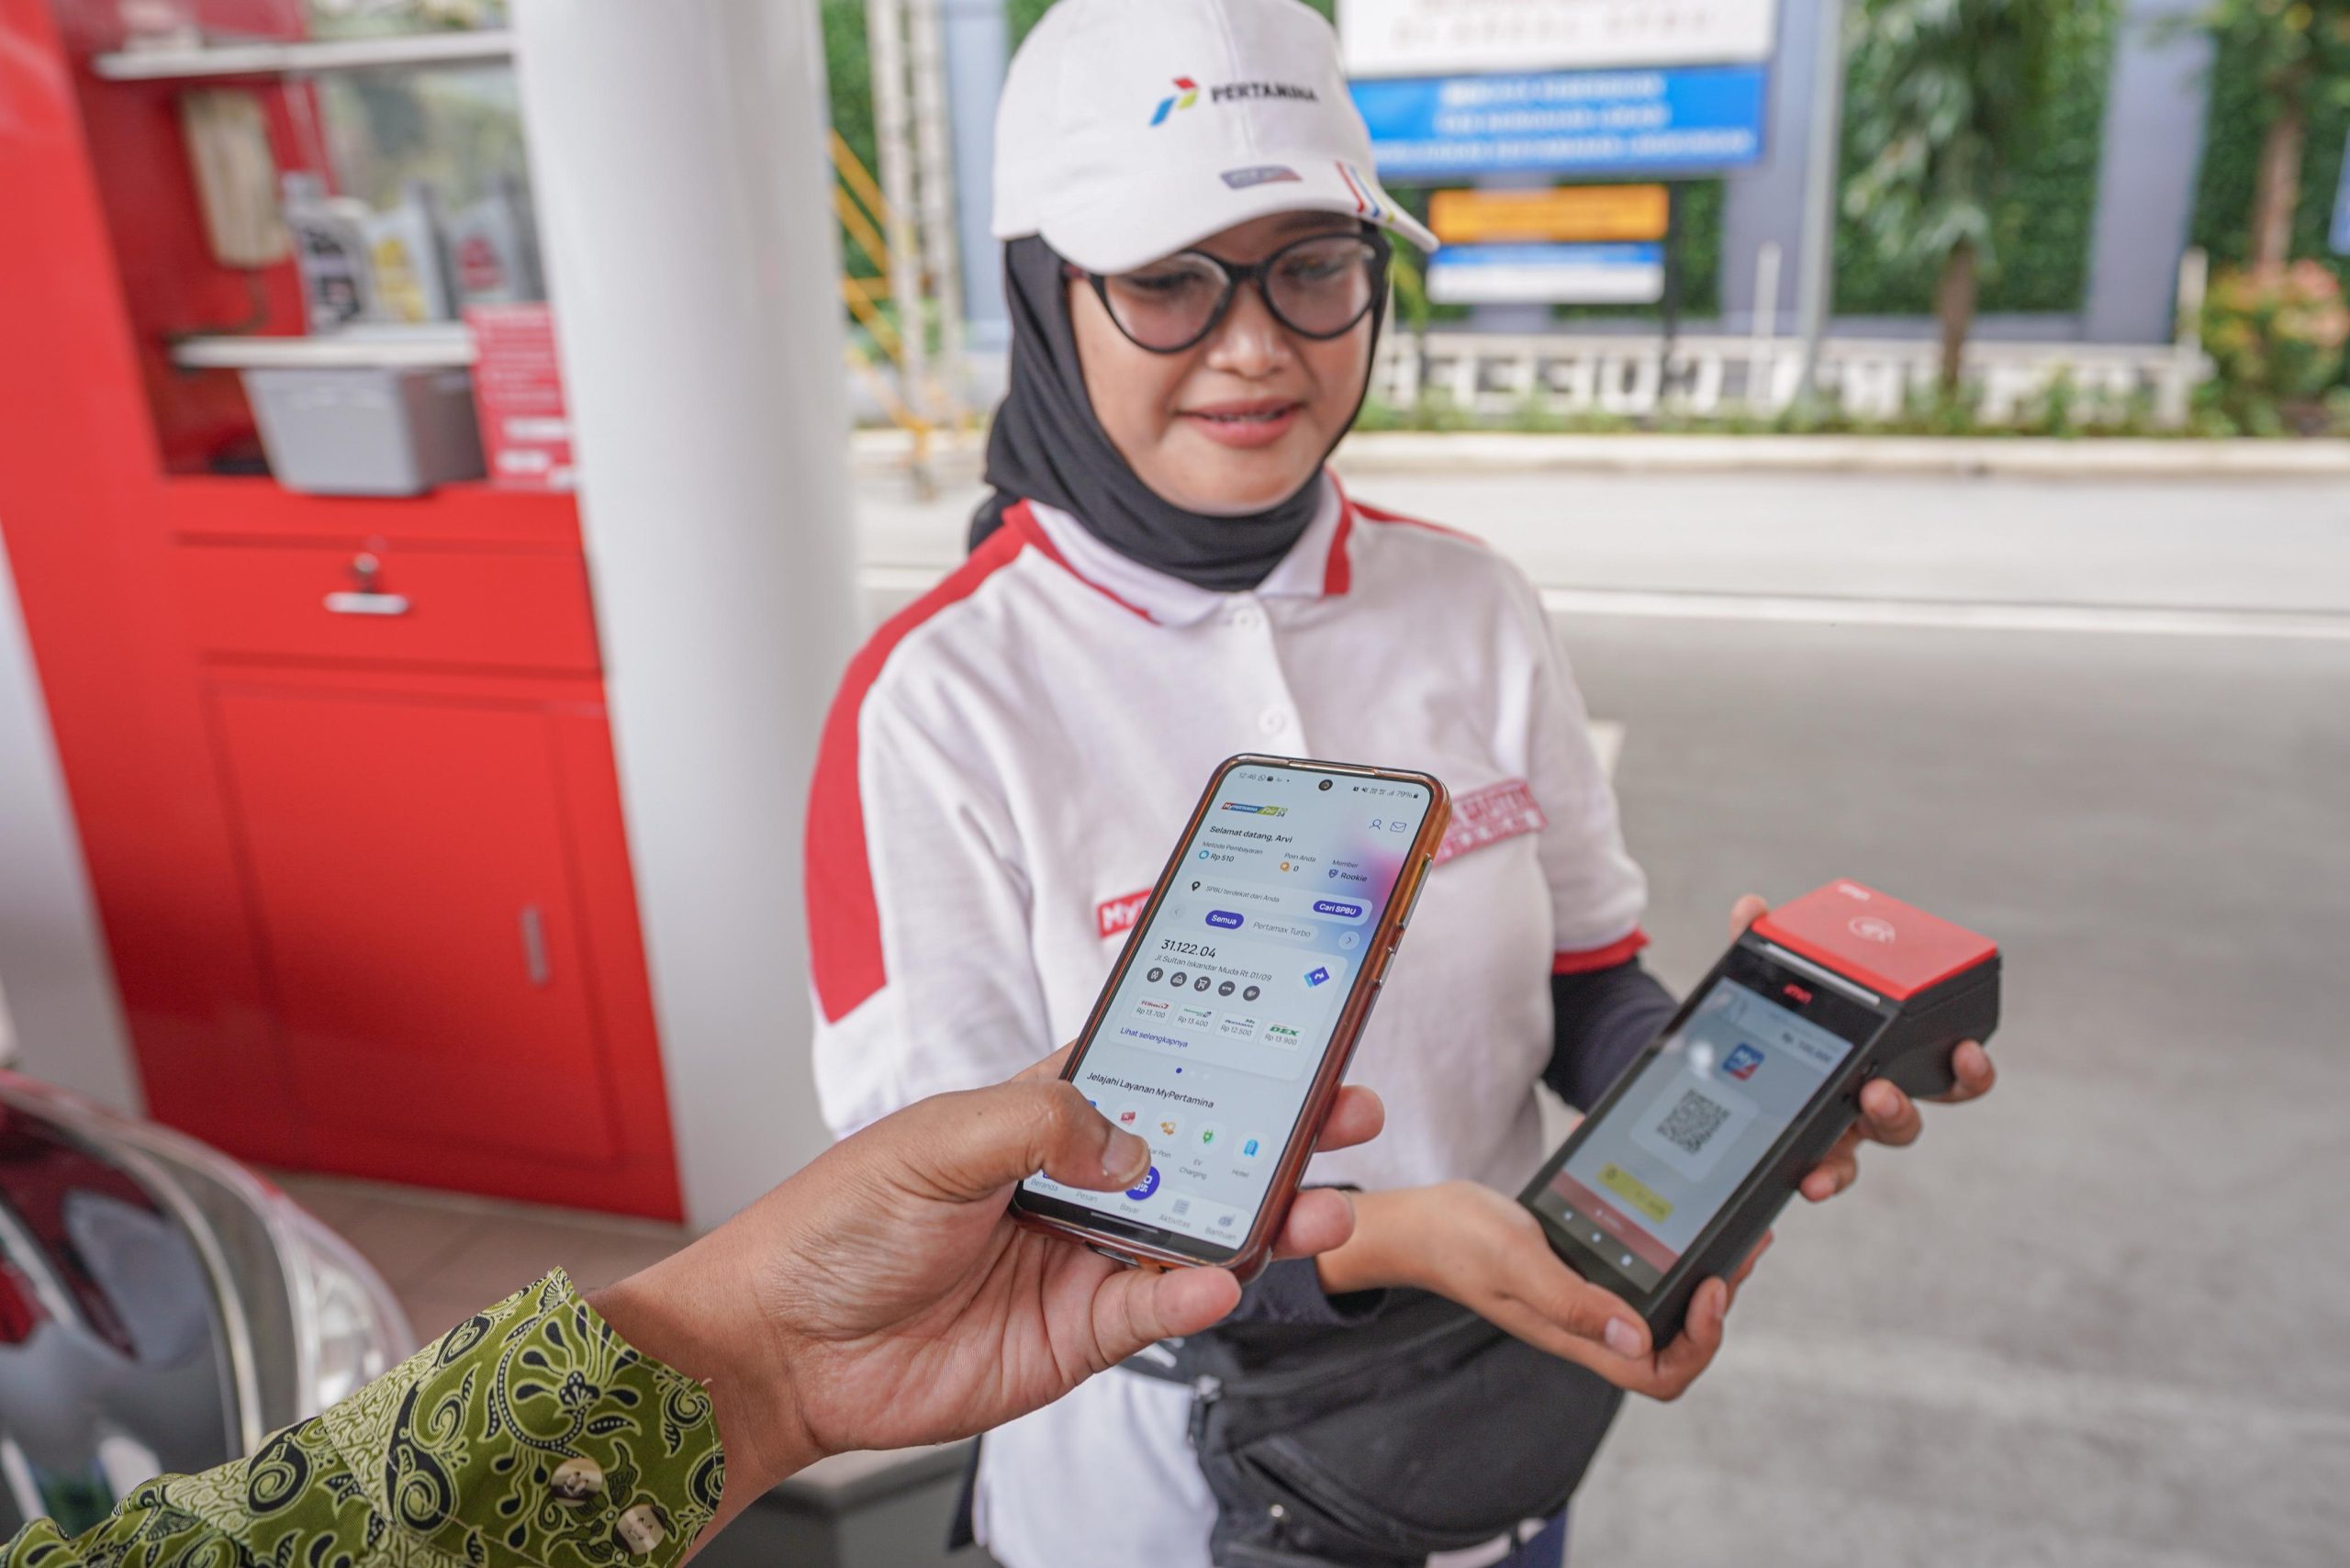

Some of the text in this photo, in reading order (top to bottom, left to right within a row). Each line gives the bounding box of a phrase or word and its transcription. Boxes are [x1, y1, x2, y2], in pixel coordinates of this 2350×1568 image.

[1209, 83, 1319, 103] PERTAMINA
[1210, 825, 1293, 844] Selamat datang, Arvi
[1202, 841, 1263, 855] Metode Pembayaran
[1210, 853, 1221, 861] Rp
[1284, 852, 1316, 863] Poin Anda
[1332, 859, 1359, 868] Member
[1340, 872, 1368, 882] Rookie
[1205, 885, 1281, 902] SPBU terdekat dari Anda
[1319, 902, 1357, 915] Cari SPBU
[1211, 914, 1237, 925] Semua
[1252, 921, 1311, 937] Pertamax Turbo
[1160, 939, 1217, 958] 31.122.04
[1187, 959, 1217, 971] Iskandar
[1218, 966, 1239, 975] Muda
[1178, 1015, 1187, 1024] Rp
[1221, 1024, 1230, 1033] Rp
[1270, 1026, 1300, 1036] DEX
[1120, 1026, 1189, 1047] Lihat selengkapnya
[1265, 1033, 1274, 1041] Rp
[1087, 1072, 1214, 1109] Jelajahi Layanan MyPertamina
[1193, 1159, 1203, 1167] EV
[1179, 1167, 1208, 1181] Charging
[1232, 1168, 1250, 1179] Hotel
[1030, 1178, 1058, 1193] Beranda
[1076, 1191, 1098, 1204] Pesan
[1119, 1203, 1140, 1215] Bayar
[1158, 1213, 1191, 1229] Aktivitas
[1205, 1226, 1237, 1240] Bantuan
